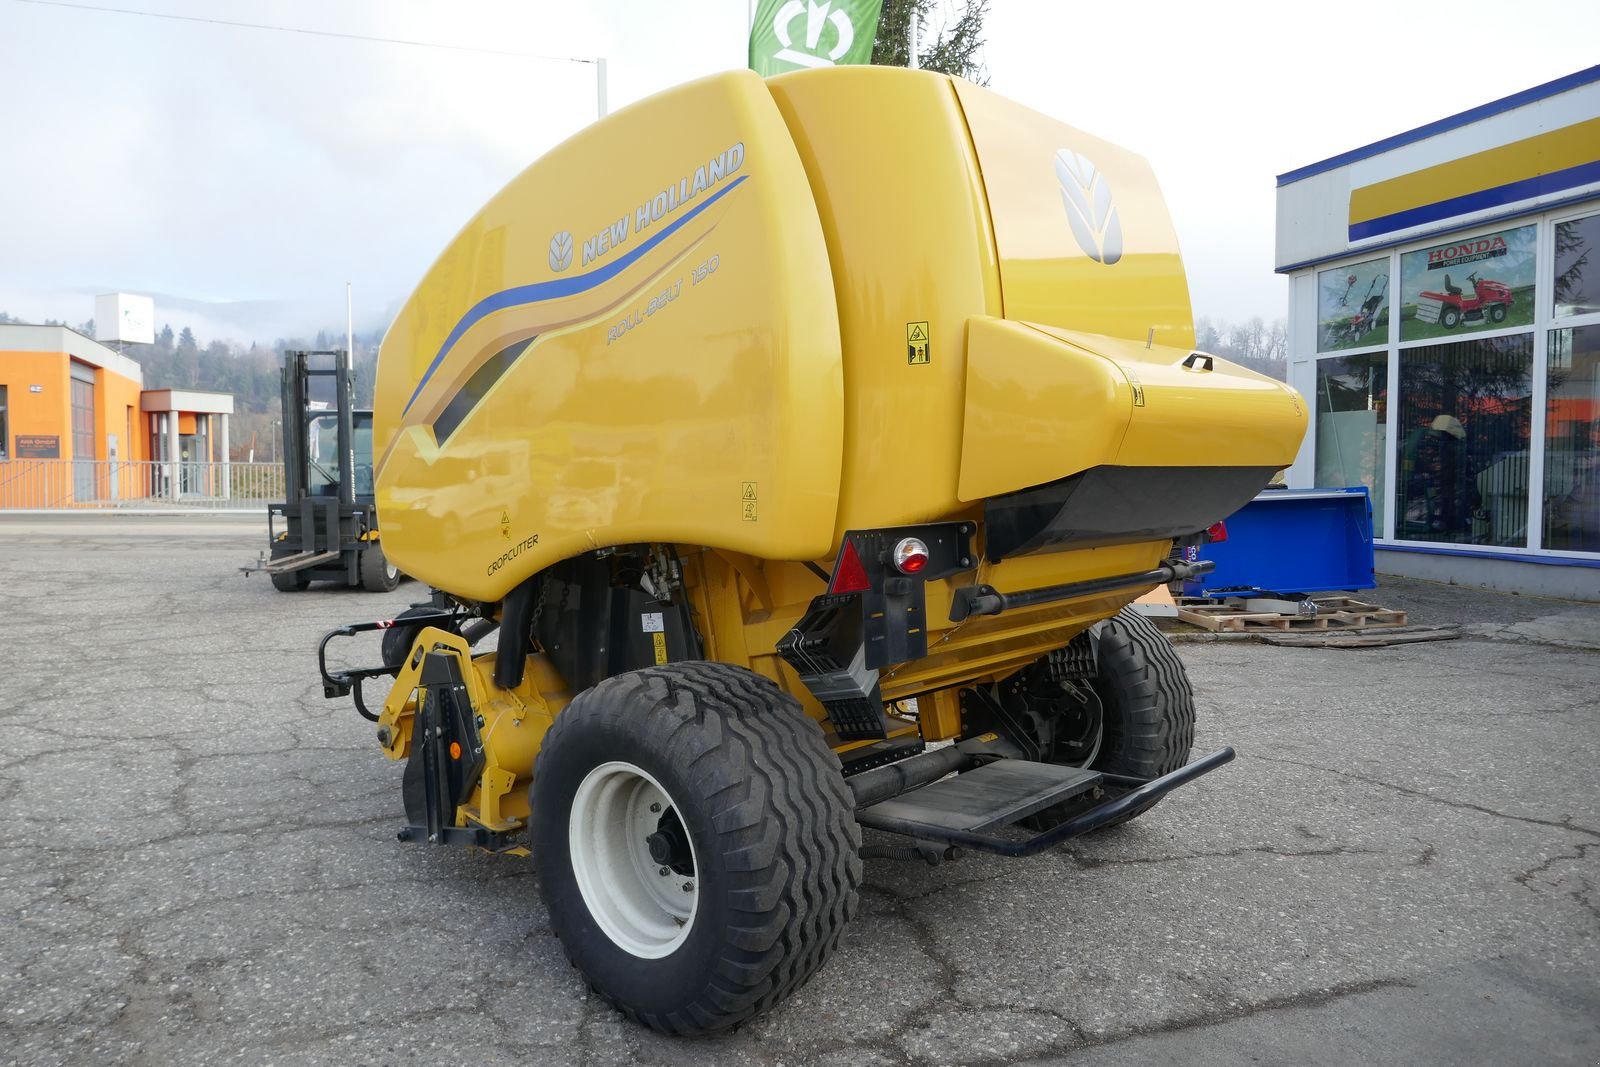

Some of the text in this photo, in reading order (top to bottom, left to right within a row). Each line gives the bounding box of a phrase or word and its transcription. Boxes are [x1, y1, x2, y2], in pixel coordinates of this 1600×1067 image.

[582, 142, 745, 267] NEW HOLLAND
[1428, 236, 1507, 262] HONDA
[607, 254, 720, 346] ROLL-BELT 150
[487, 533, 539, 577] CROPCUTTER
